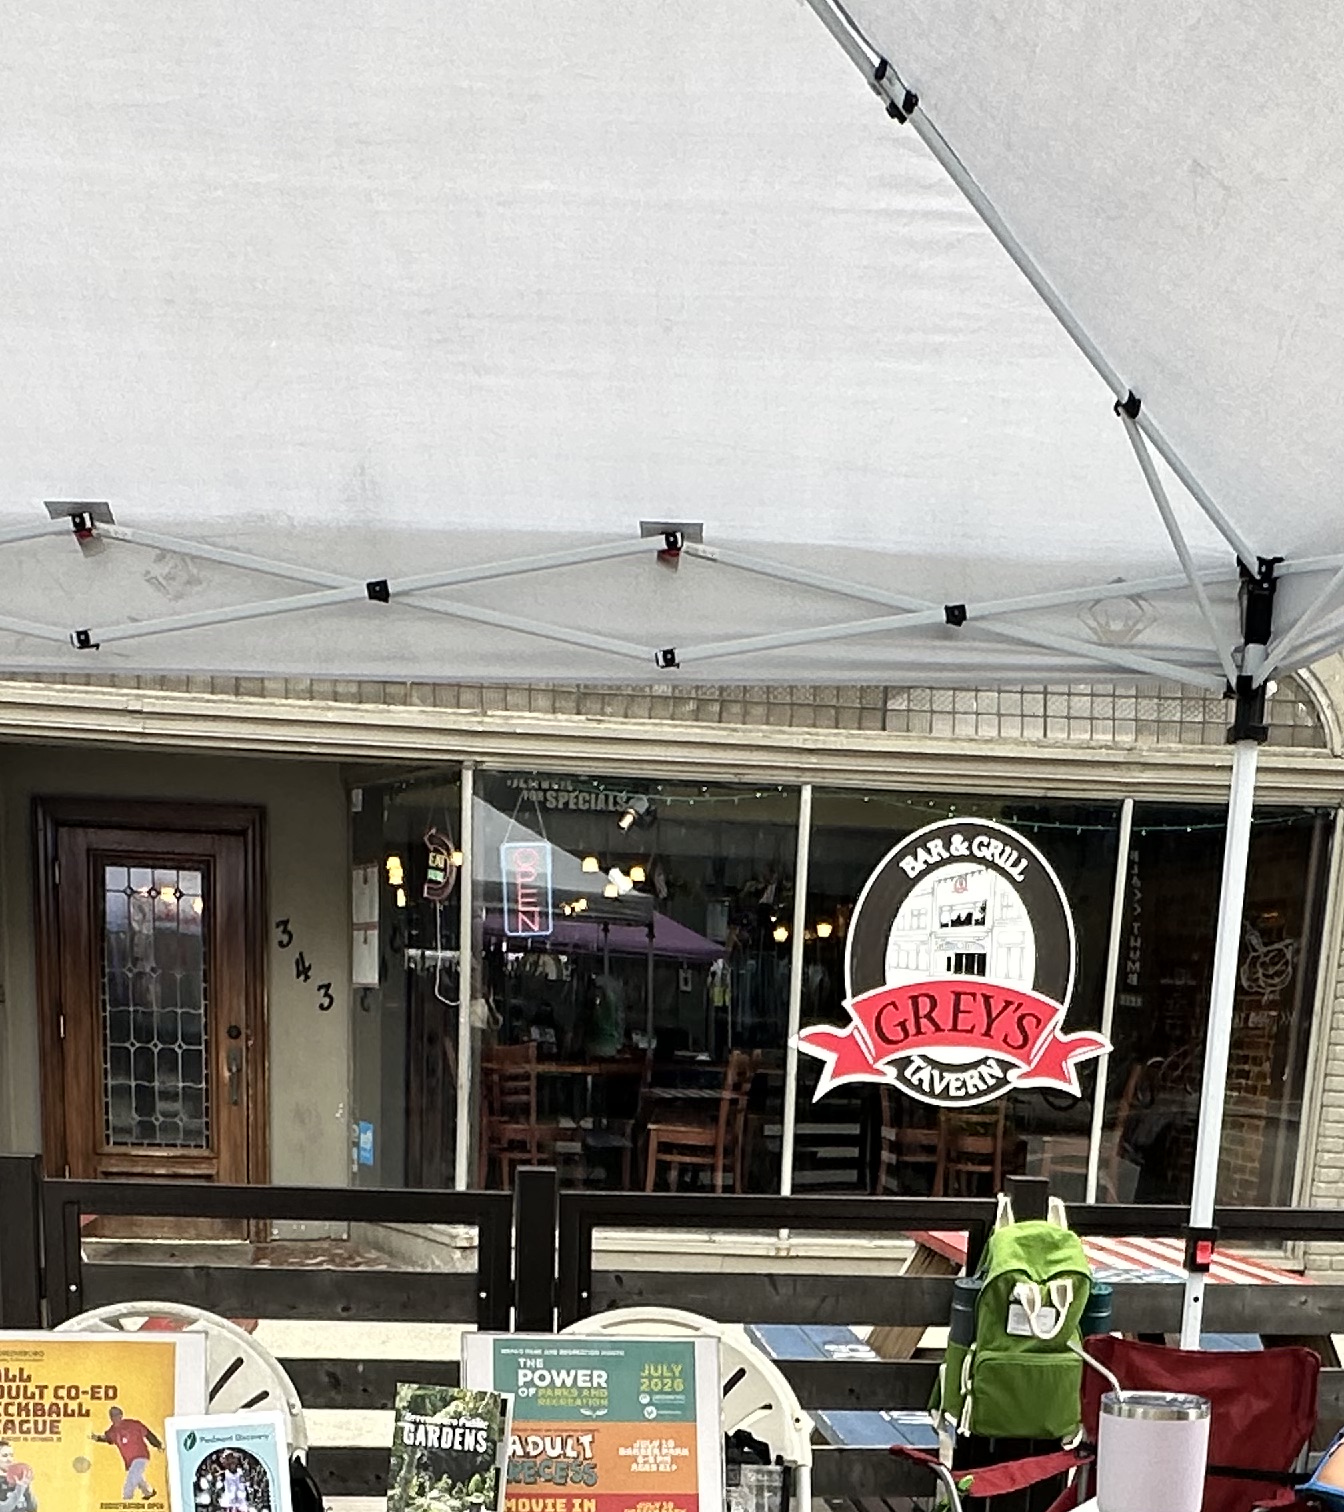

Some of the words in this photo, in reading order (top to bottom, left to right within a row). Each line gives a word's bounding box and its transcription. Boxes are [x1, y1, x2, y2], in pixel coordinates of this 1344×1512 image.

[546, 790, 626, 812] SPECIALS
[899, 838, 949, 878] BAR
[950, 834, 970, 857] &
[971, 835, 1029, 882] GRILL
[514, 848, 540, 934] OPEN
[275, 919, 334, 1012] 343
[874, 991, 1042, 1051] GREY'S
[902, 1055, 1007, 1097] TAVERN
[518, 1358, 543, 1368] THE
[640, 1363, 683, 1377] JULY
[518, 1369, 608, 1387] POWER
[53, 1385, 118, 1400] CO-ED
[518, 1387, 537, 1398] OF
[403, 1422, 488, 1454] GARDENS
[507, 1434, 594, 1459] ADULT
[507, 1460, 598, 1487] RECESS
[503, 1499, 567, 1512] MOVIE
[572, 1499, 597, 1512] IN
